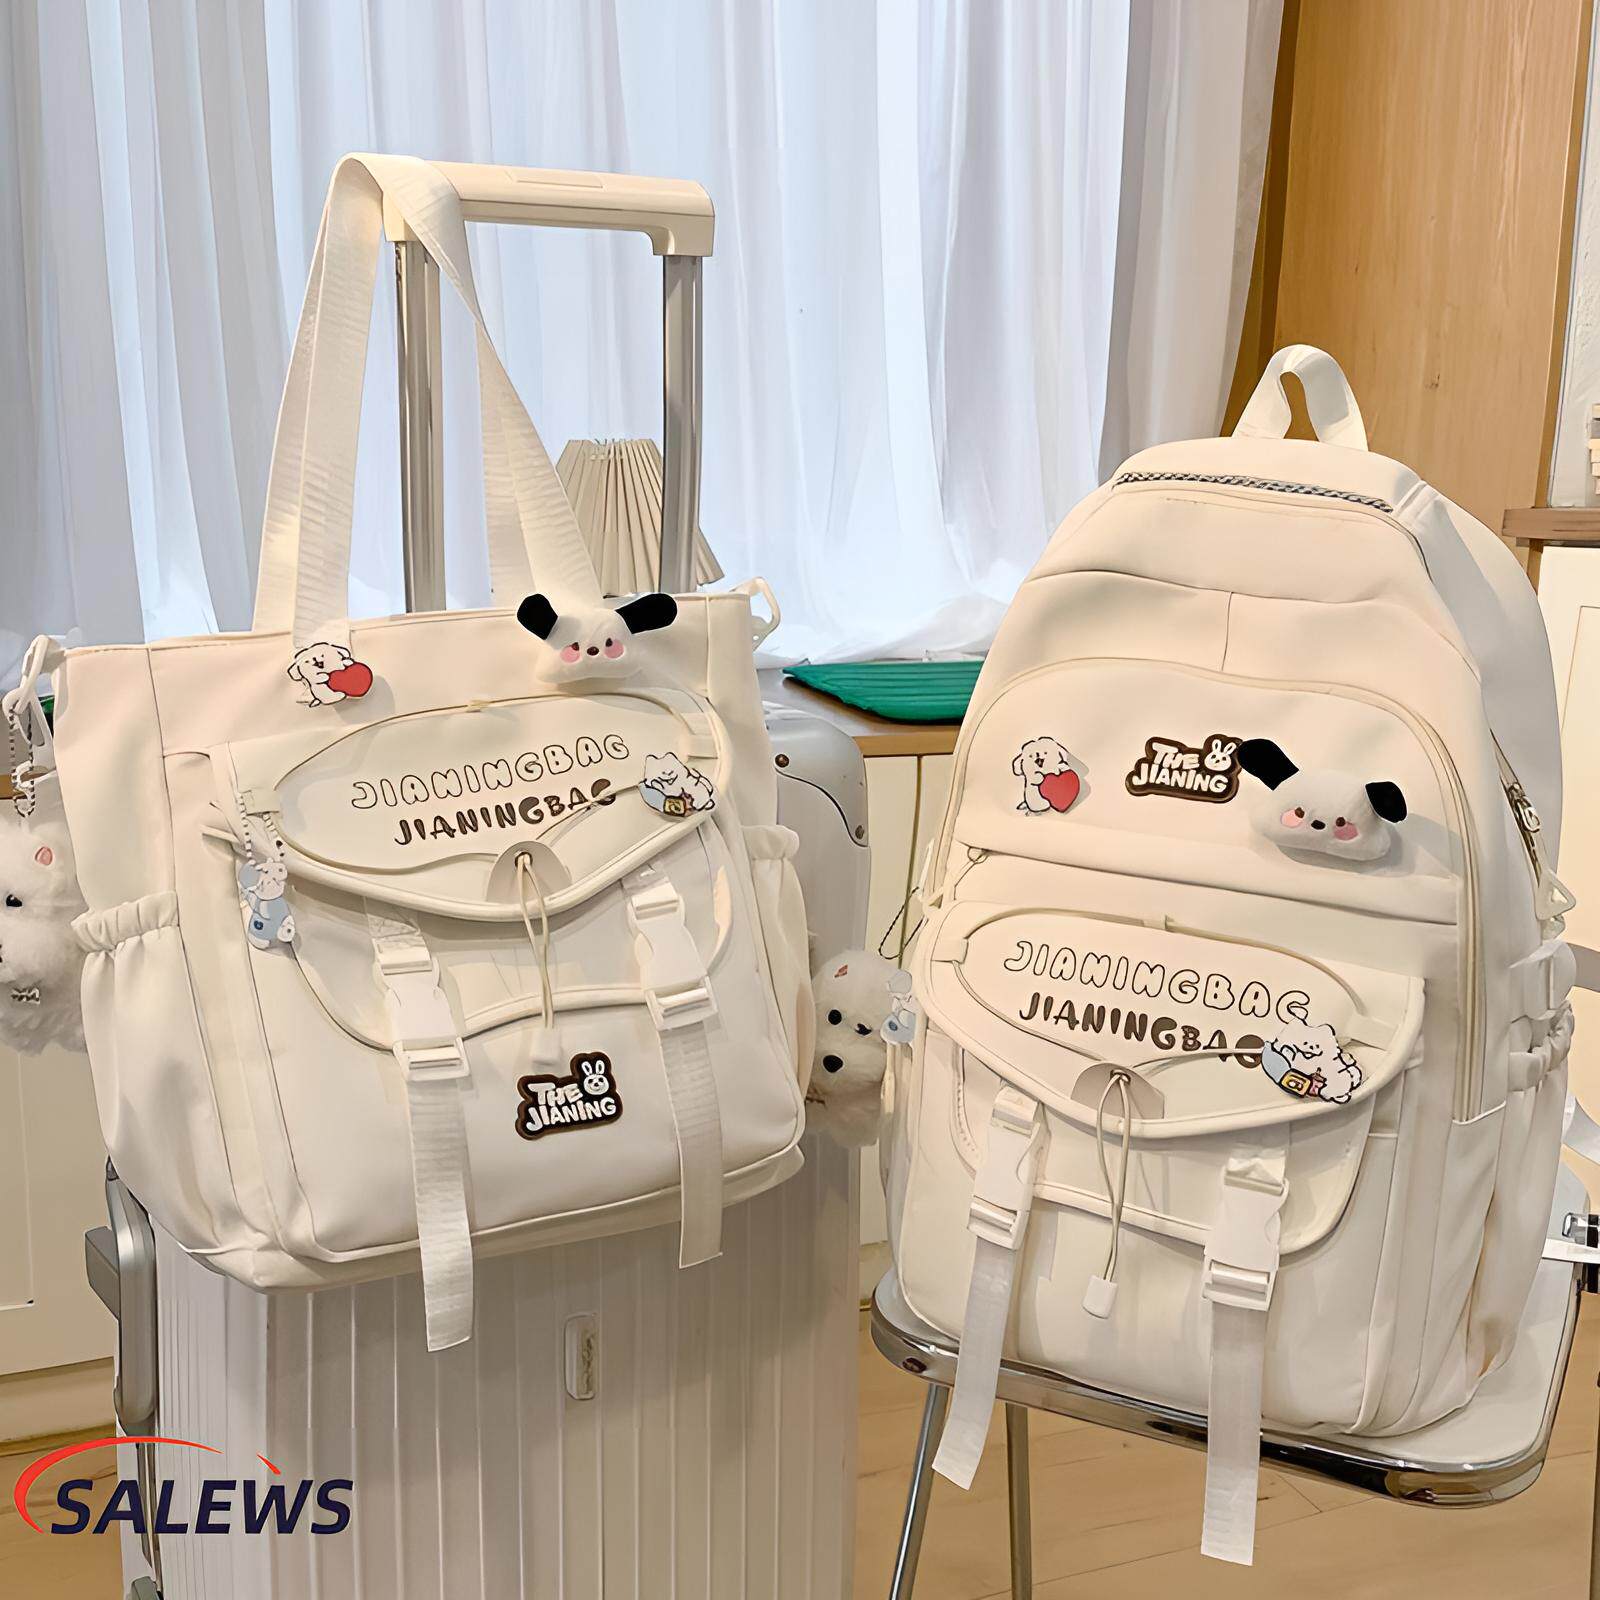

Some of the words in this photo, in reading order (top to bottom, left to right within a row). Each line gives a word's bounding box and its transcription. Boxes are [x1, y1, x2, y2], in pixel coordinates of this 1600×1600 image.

[351, 734, 630, 809] JIANINGBAG
[1151, 742, 1200, 769] THE
[1132, 762, 1229, 793] JIANING
[1003, 940, 1311, 1025] JIANINGBAG
[527, 1082, 583, 1107] THE
[526, 1096, 617, 1132] JIANING
